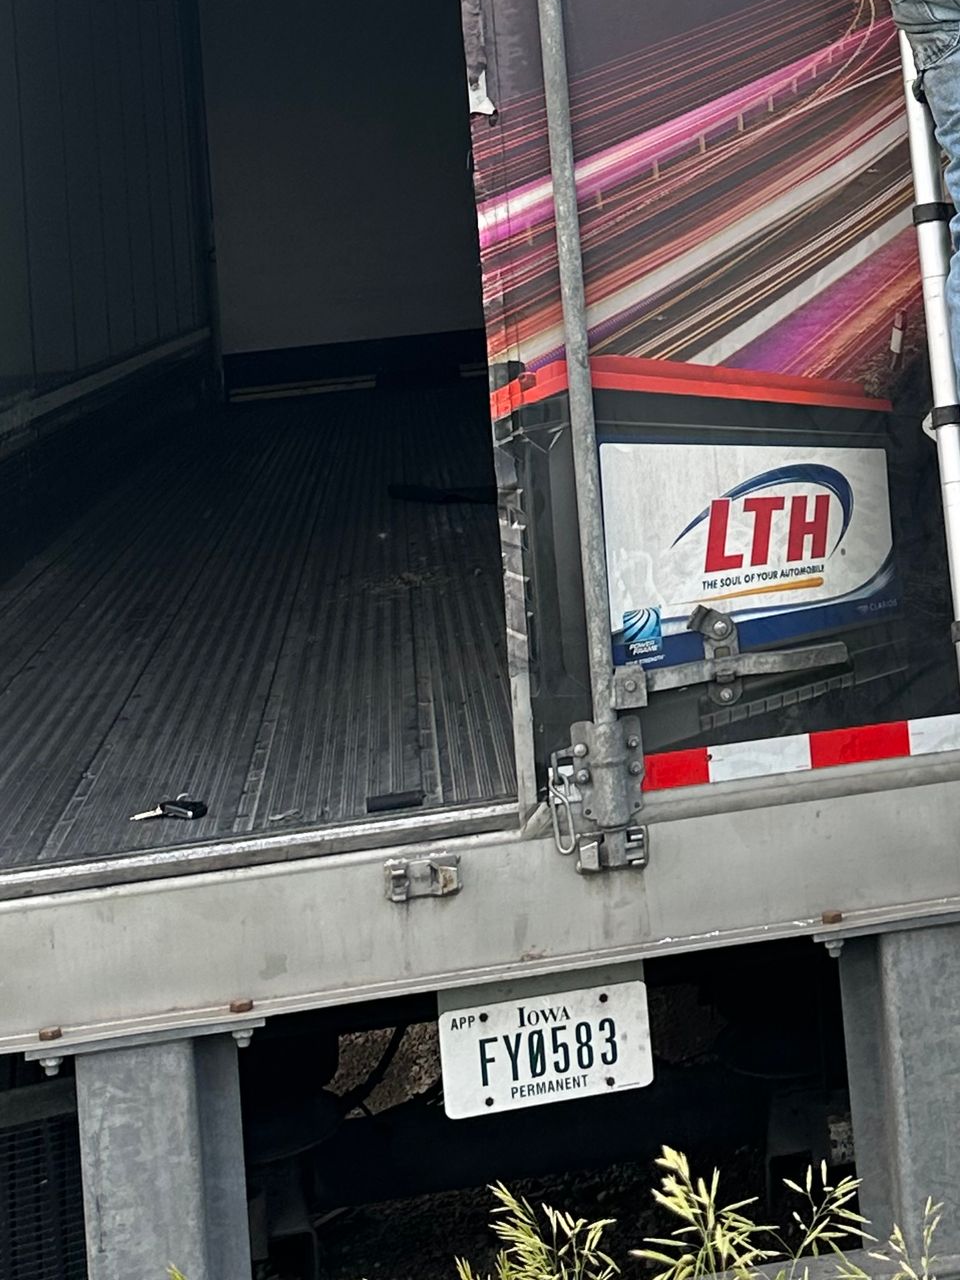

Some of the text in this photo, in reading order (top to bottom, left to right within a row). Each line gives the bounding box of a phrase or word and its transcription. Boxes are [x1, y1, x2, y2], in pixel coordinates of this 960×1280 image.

[703, 494, 831, 573] LTH
[702, 564, 825, 589] THE SOUL OF YOUR AUTOMOBILE
[450, 1015, 476, 1031] APP
[510, 1074, 589, 1099] PERMANENT
